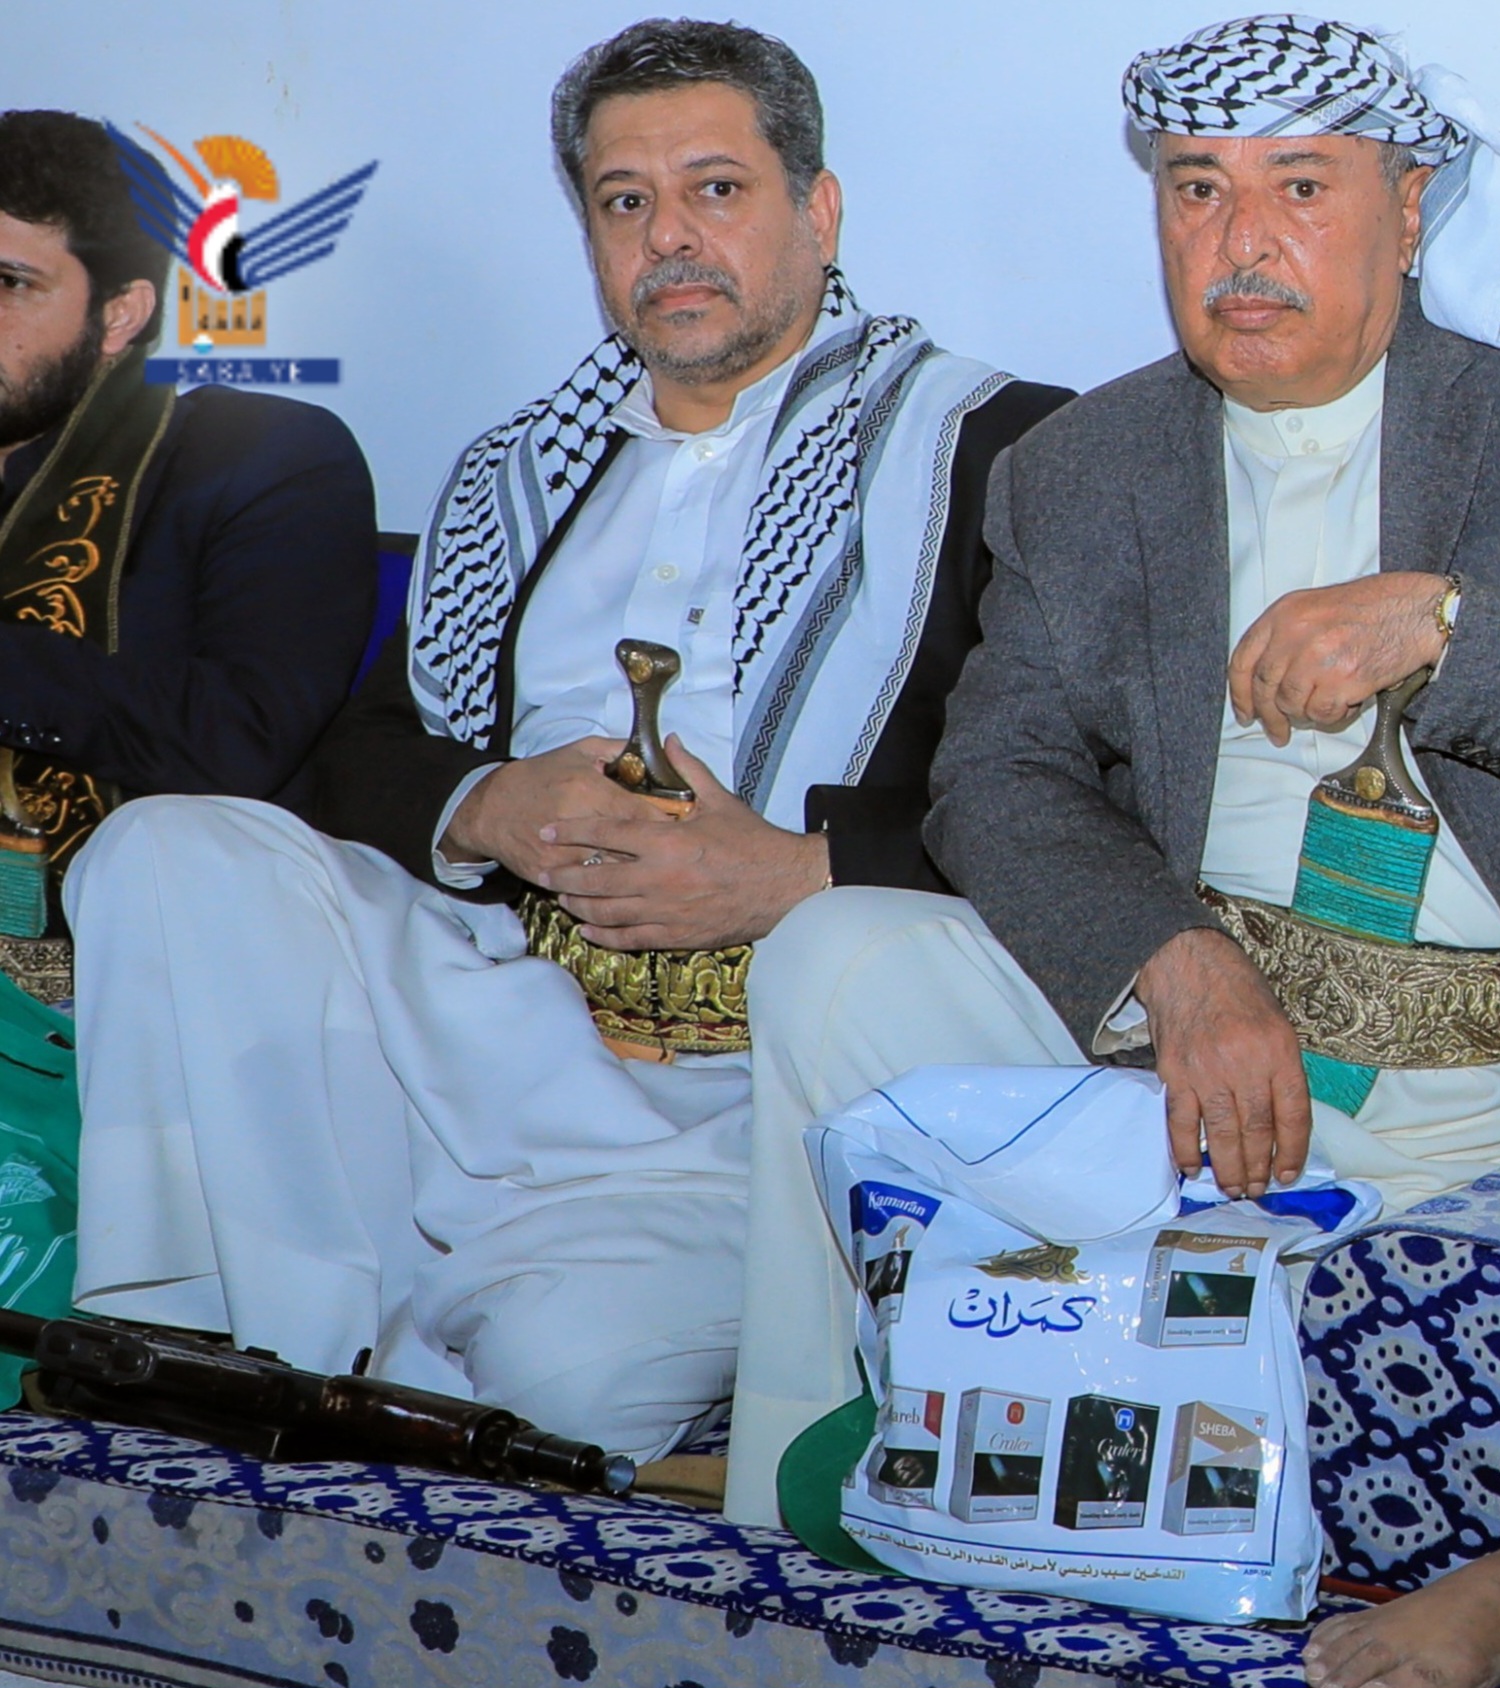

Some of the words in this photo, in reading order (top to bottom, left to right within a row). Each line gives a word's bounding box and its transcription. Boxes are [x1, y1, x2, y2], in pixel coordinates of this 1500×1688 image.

[948, 1287, 1098, 1339] كمران
[889, 1407, 921, 1425] areb
[1199, 1421, 1237, 1439] SHEBA
[931, 1542, 973, 1564] والرئة
[974, 1553, 1009, 1567] القلب
[1010, 1557, 1057, 1573] لأمراض
[1059, 1563, 1099, 1579] رئيسي
[1101, 1567, 1131, 1580] سبب
[1134, 1568, 1186, 1581] التدخين
